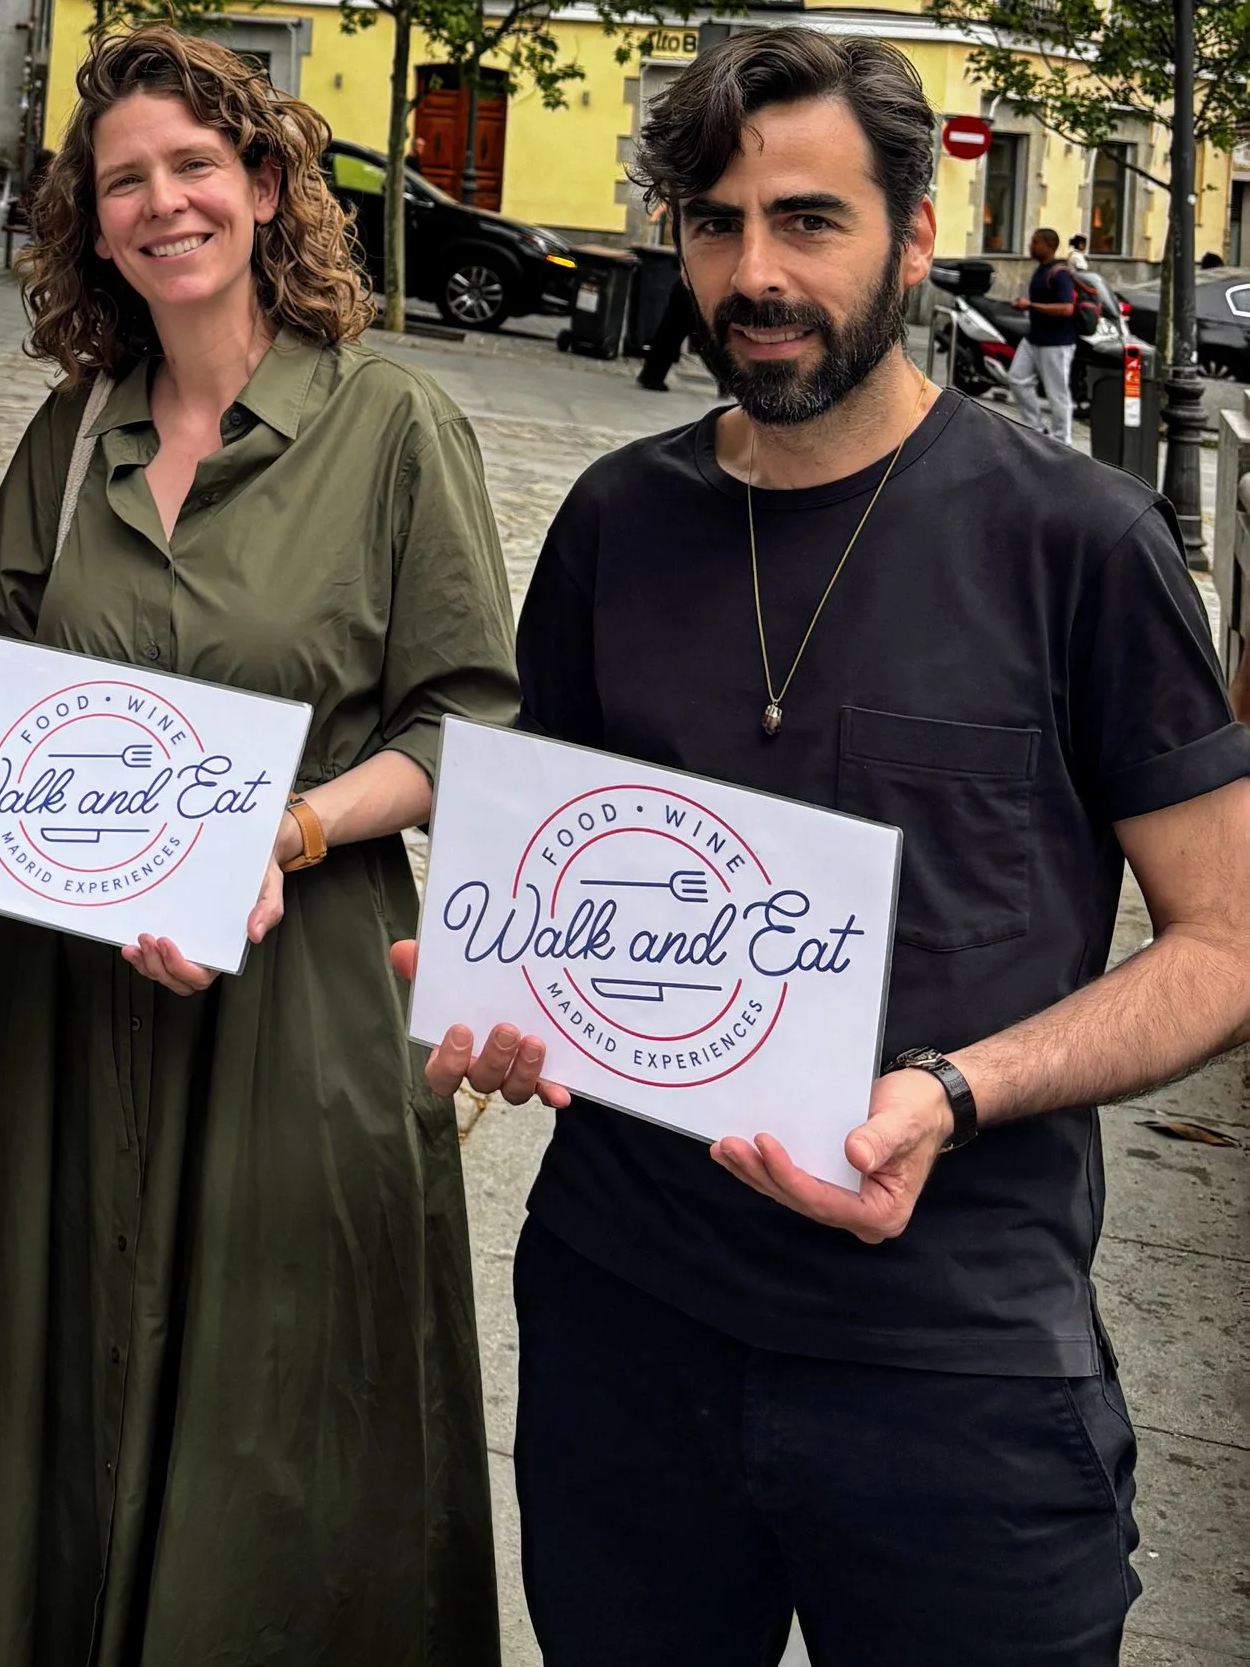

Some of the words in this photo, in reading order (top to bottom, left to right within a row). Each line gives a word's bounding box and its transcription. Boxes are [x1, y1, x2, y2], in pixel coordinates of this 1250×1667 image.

[20, 695, 89, 744] FOOD
[128, 695, 187, 746] WINE
[78, 767, 172, 815] and
[177, 756, 272, 819] Eat
[1, 831, 52, 884] MADRID
[65, 836, 181, 894] EXPERIENCES
[542, 804, 617, 866] FOOD
[665, 805, 746, 874] WINE
[443, 881, 617, 963] Walk
[629, 903, 737, 966] and
[743, 890, 864, 977] Eat
[547, 982, 616, 1053] MADRID
[633, 998, 763, 1070] EXPERIENCES
